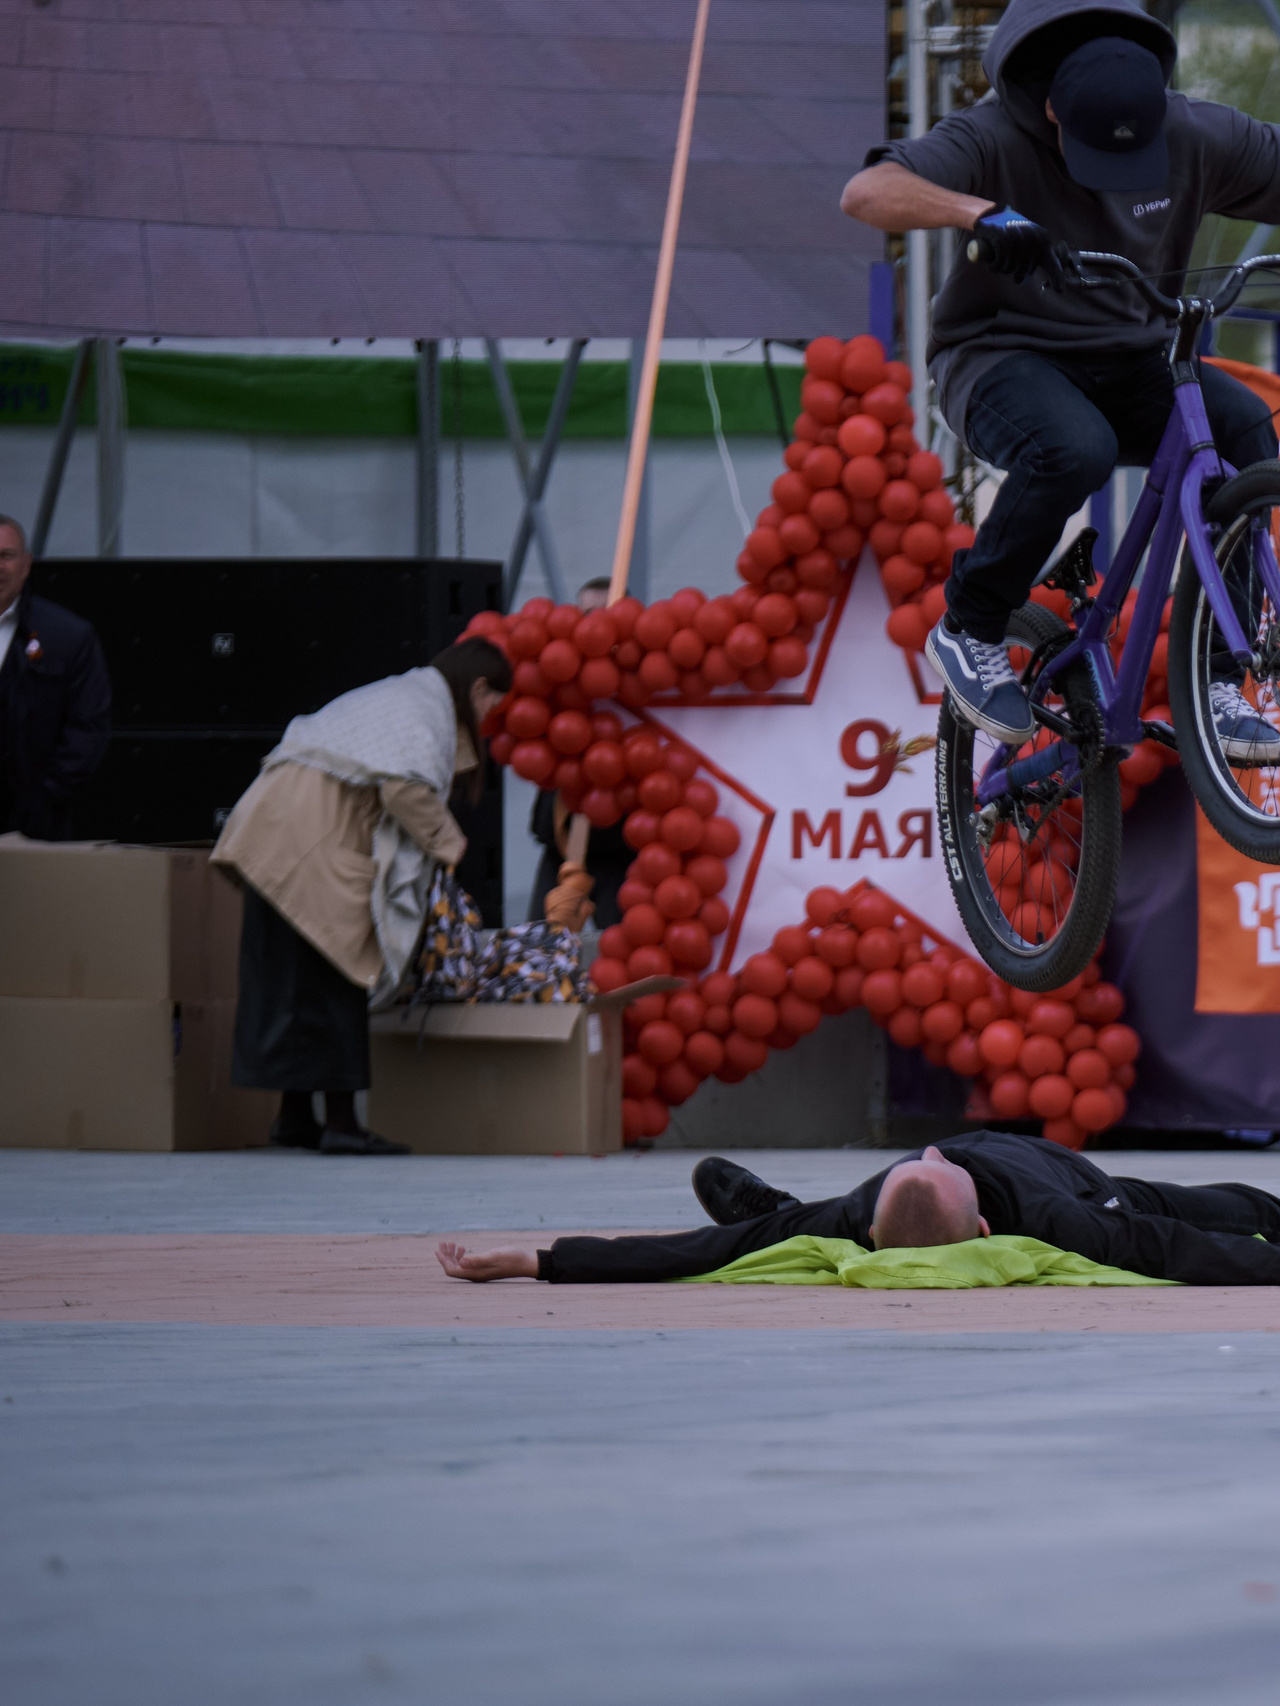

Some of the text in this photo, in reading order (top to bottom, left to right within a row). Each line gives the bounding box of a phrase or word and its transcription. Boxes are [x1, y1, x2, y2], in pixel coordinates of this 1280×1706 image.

[840, 717, 899, 797] 9
[791, 808, 932, 860] МАЯ
[937, 738, 963, 880] CST ALL TERRAINS
